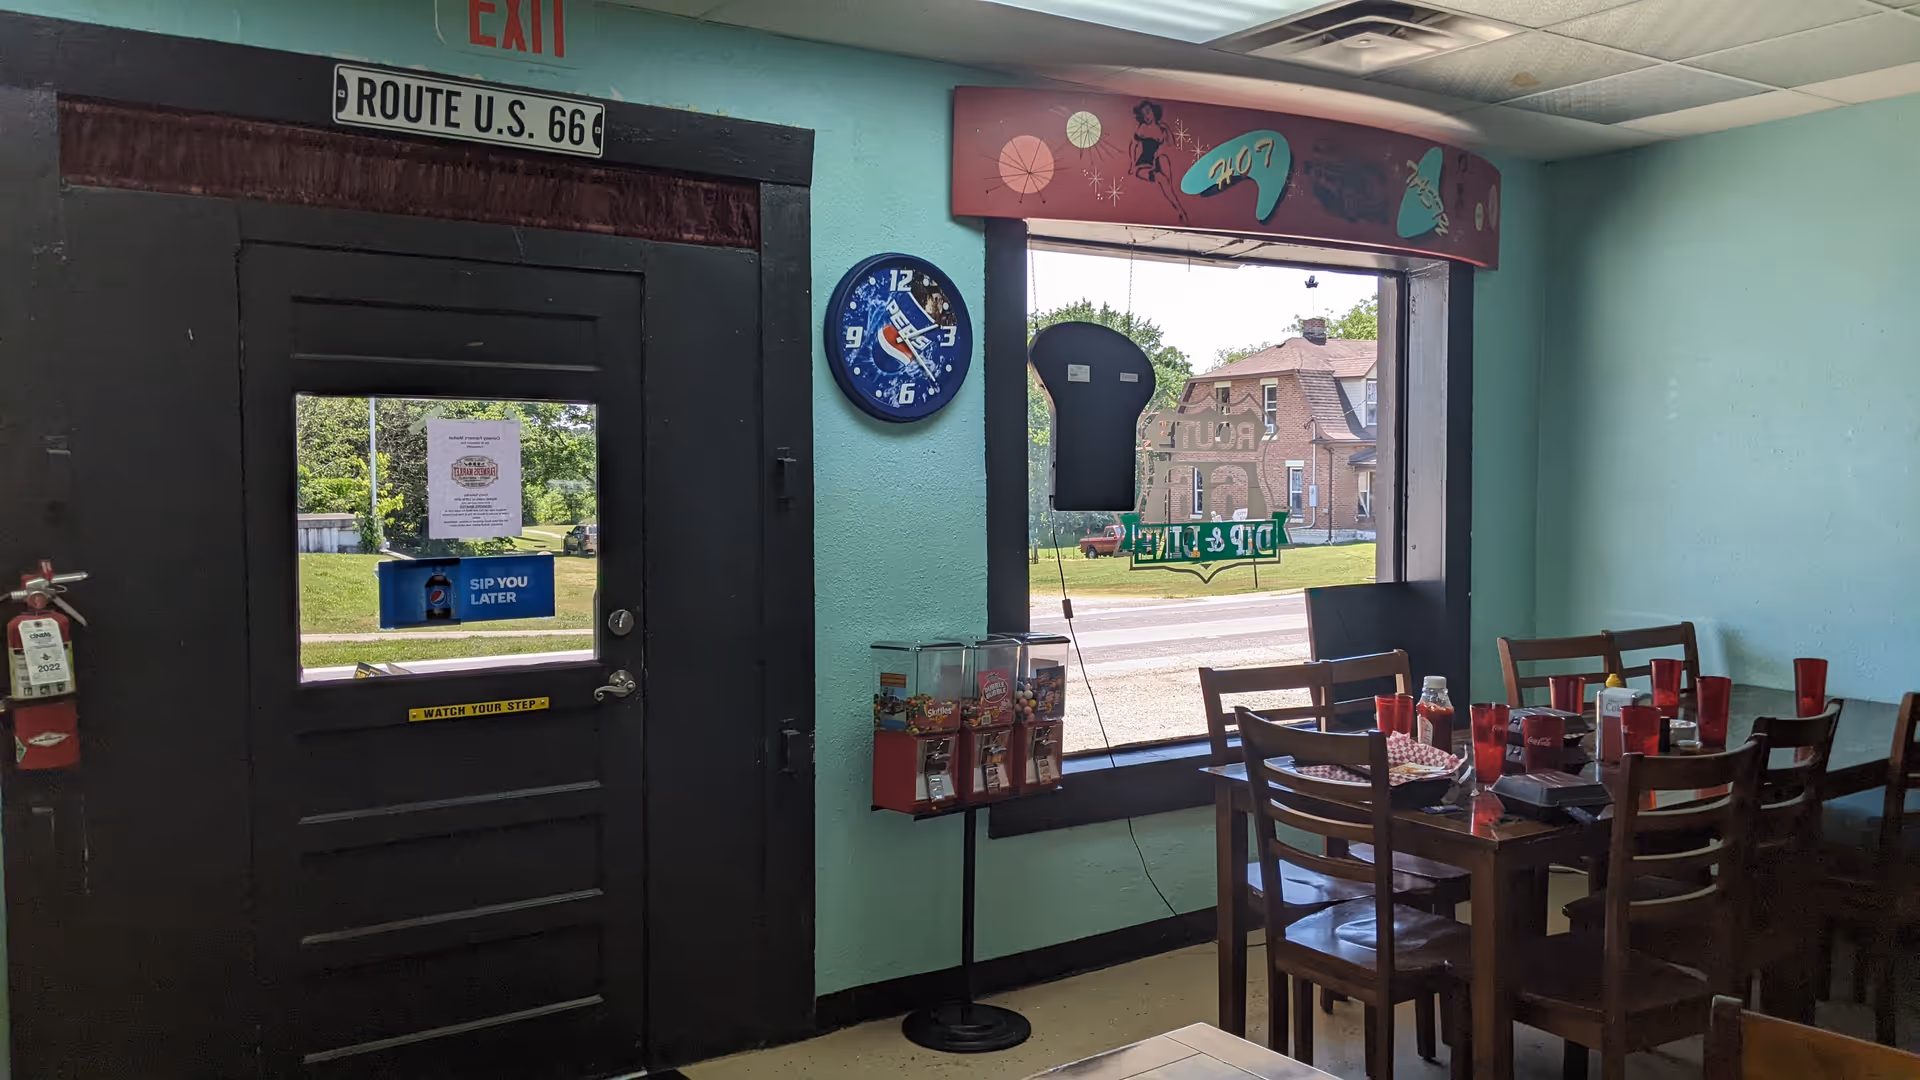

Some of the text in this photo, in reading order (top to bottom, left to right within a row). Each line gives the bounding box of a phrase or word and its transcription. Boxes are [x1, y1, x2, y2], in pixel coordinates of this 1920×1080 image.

[356, 76, 586, 146] ROUTE U.S. 66
[889, 269, 913, 292] 12
[845, 326, 863, 348] 9
[940, 325, 957, 347] 3
[899, 383, 915, 405] 6
[470, 576, 528, 591] SIP YOU
[470, 591, 517, 605] LATER
[37, 663, 61, 673] 2022
[423, 700, 536, 719] WATCH YOUR STEP
